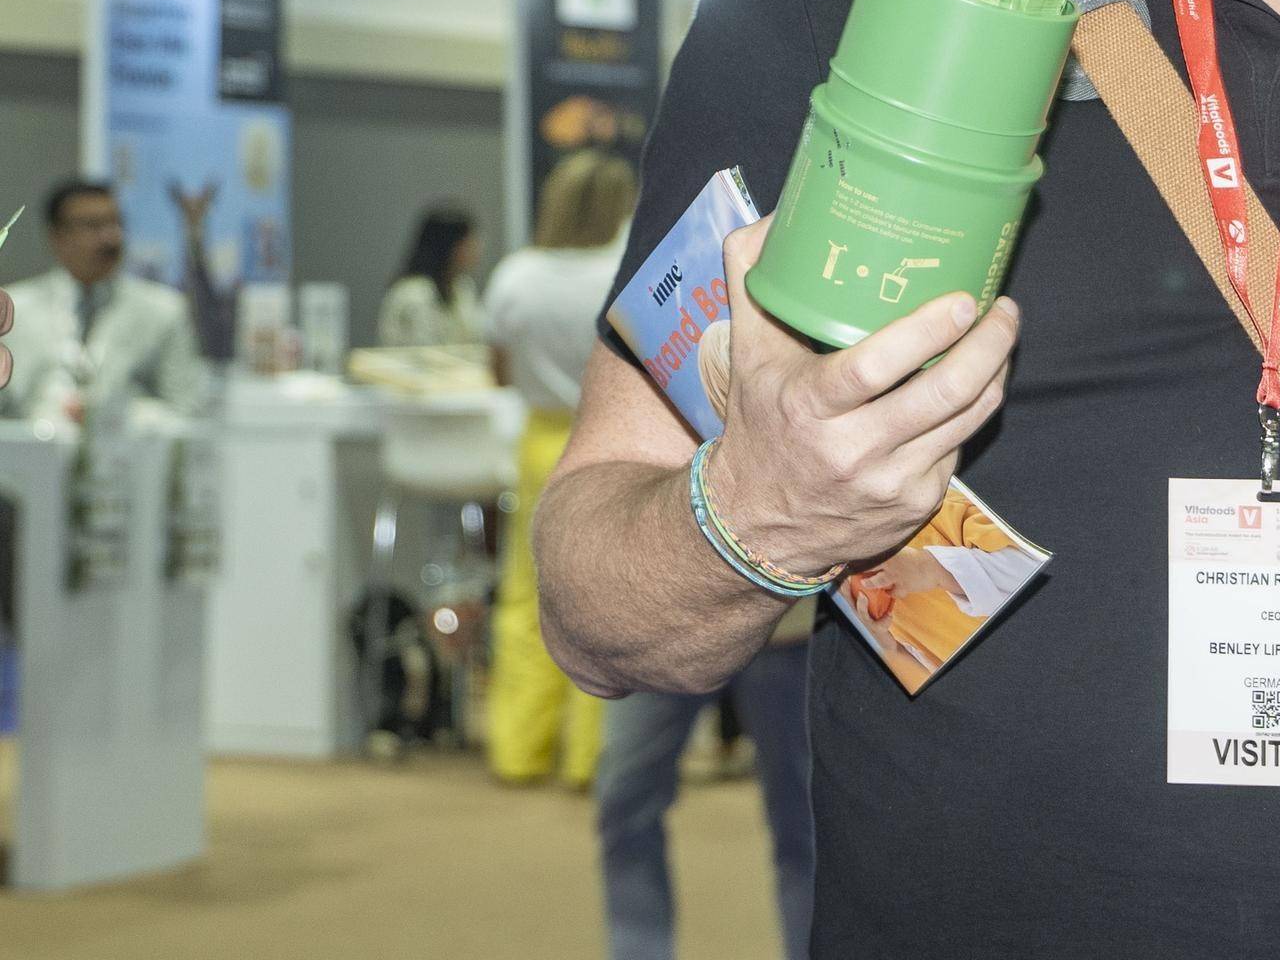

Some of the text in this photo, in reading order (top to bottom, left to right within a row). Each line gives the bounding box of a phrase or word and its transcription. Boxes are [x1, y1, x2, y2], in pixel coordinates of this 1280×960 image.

[1206, 94, 1232, 155] Vitafoods
[691, 278, 730, 320] Bo
[1185, 505, 1236, 516] Vitafoods
[1185, 515, 1208, 524] Asia
[1196, 571, 1270, 586] CHRISTIAN
[1209, 642, 1260, 656] BENLEY
